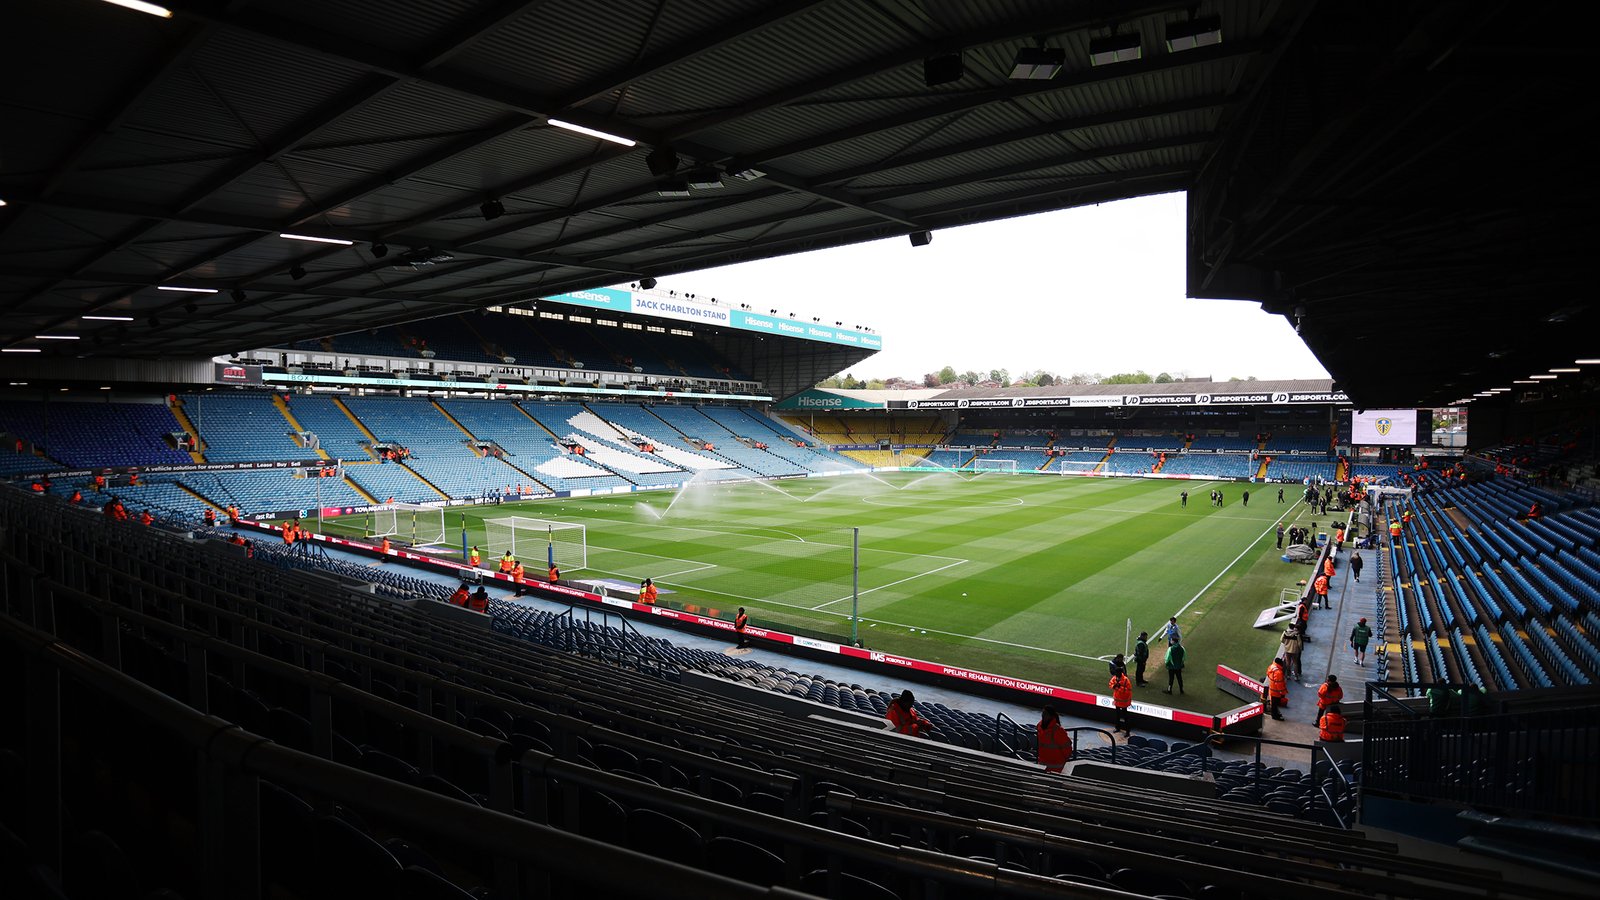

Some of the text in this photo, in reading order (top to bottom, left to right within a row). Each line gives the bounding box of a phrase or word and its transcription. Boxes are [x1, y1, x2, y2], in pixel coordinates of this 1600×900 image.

[636, 299, 727, 320] JACK CHARLTON STAND
[744, 316, 774, 329] Hisense
[778, 322, 804, 334] Hisense
[808, 327, 832, 339] Hisense
[836, 332, 858, 343] Hisense
[798, 396, 842, 406] Hisense
[714, 621, 736, 630] REHABILITA
[745, 628, 767, 637] QUIPMENT
[870, 652, 885, 662] IMS
[886, 657, 906, 665] ROBOTICS
[943, 668, 1054, 695] PIPELINE REHABILITATION EQUIPMENT
[1238, 676, 1258, 691] PIPELINE
[1143, 705, 1168, 717] PARTNER
[1226, 713, 1239, 726] IMS
[1239, 710, 1255, 719] ROBOTICS
